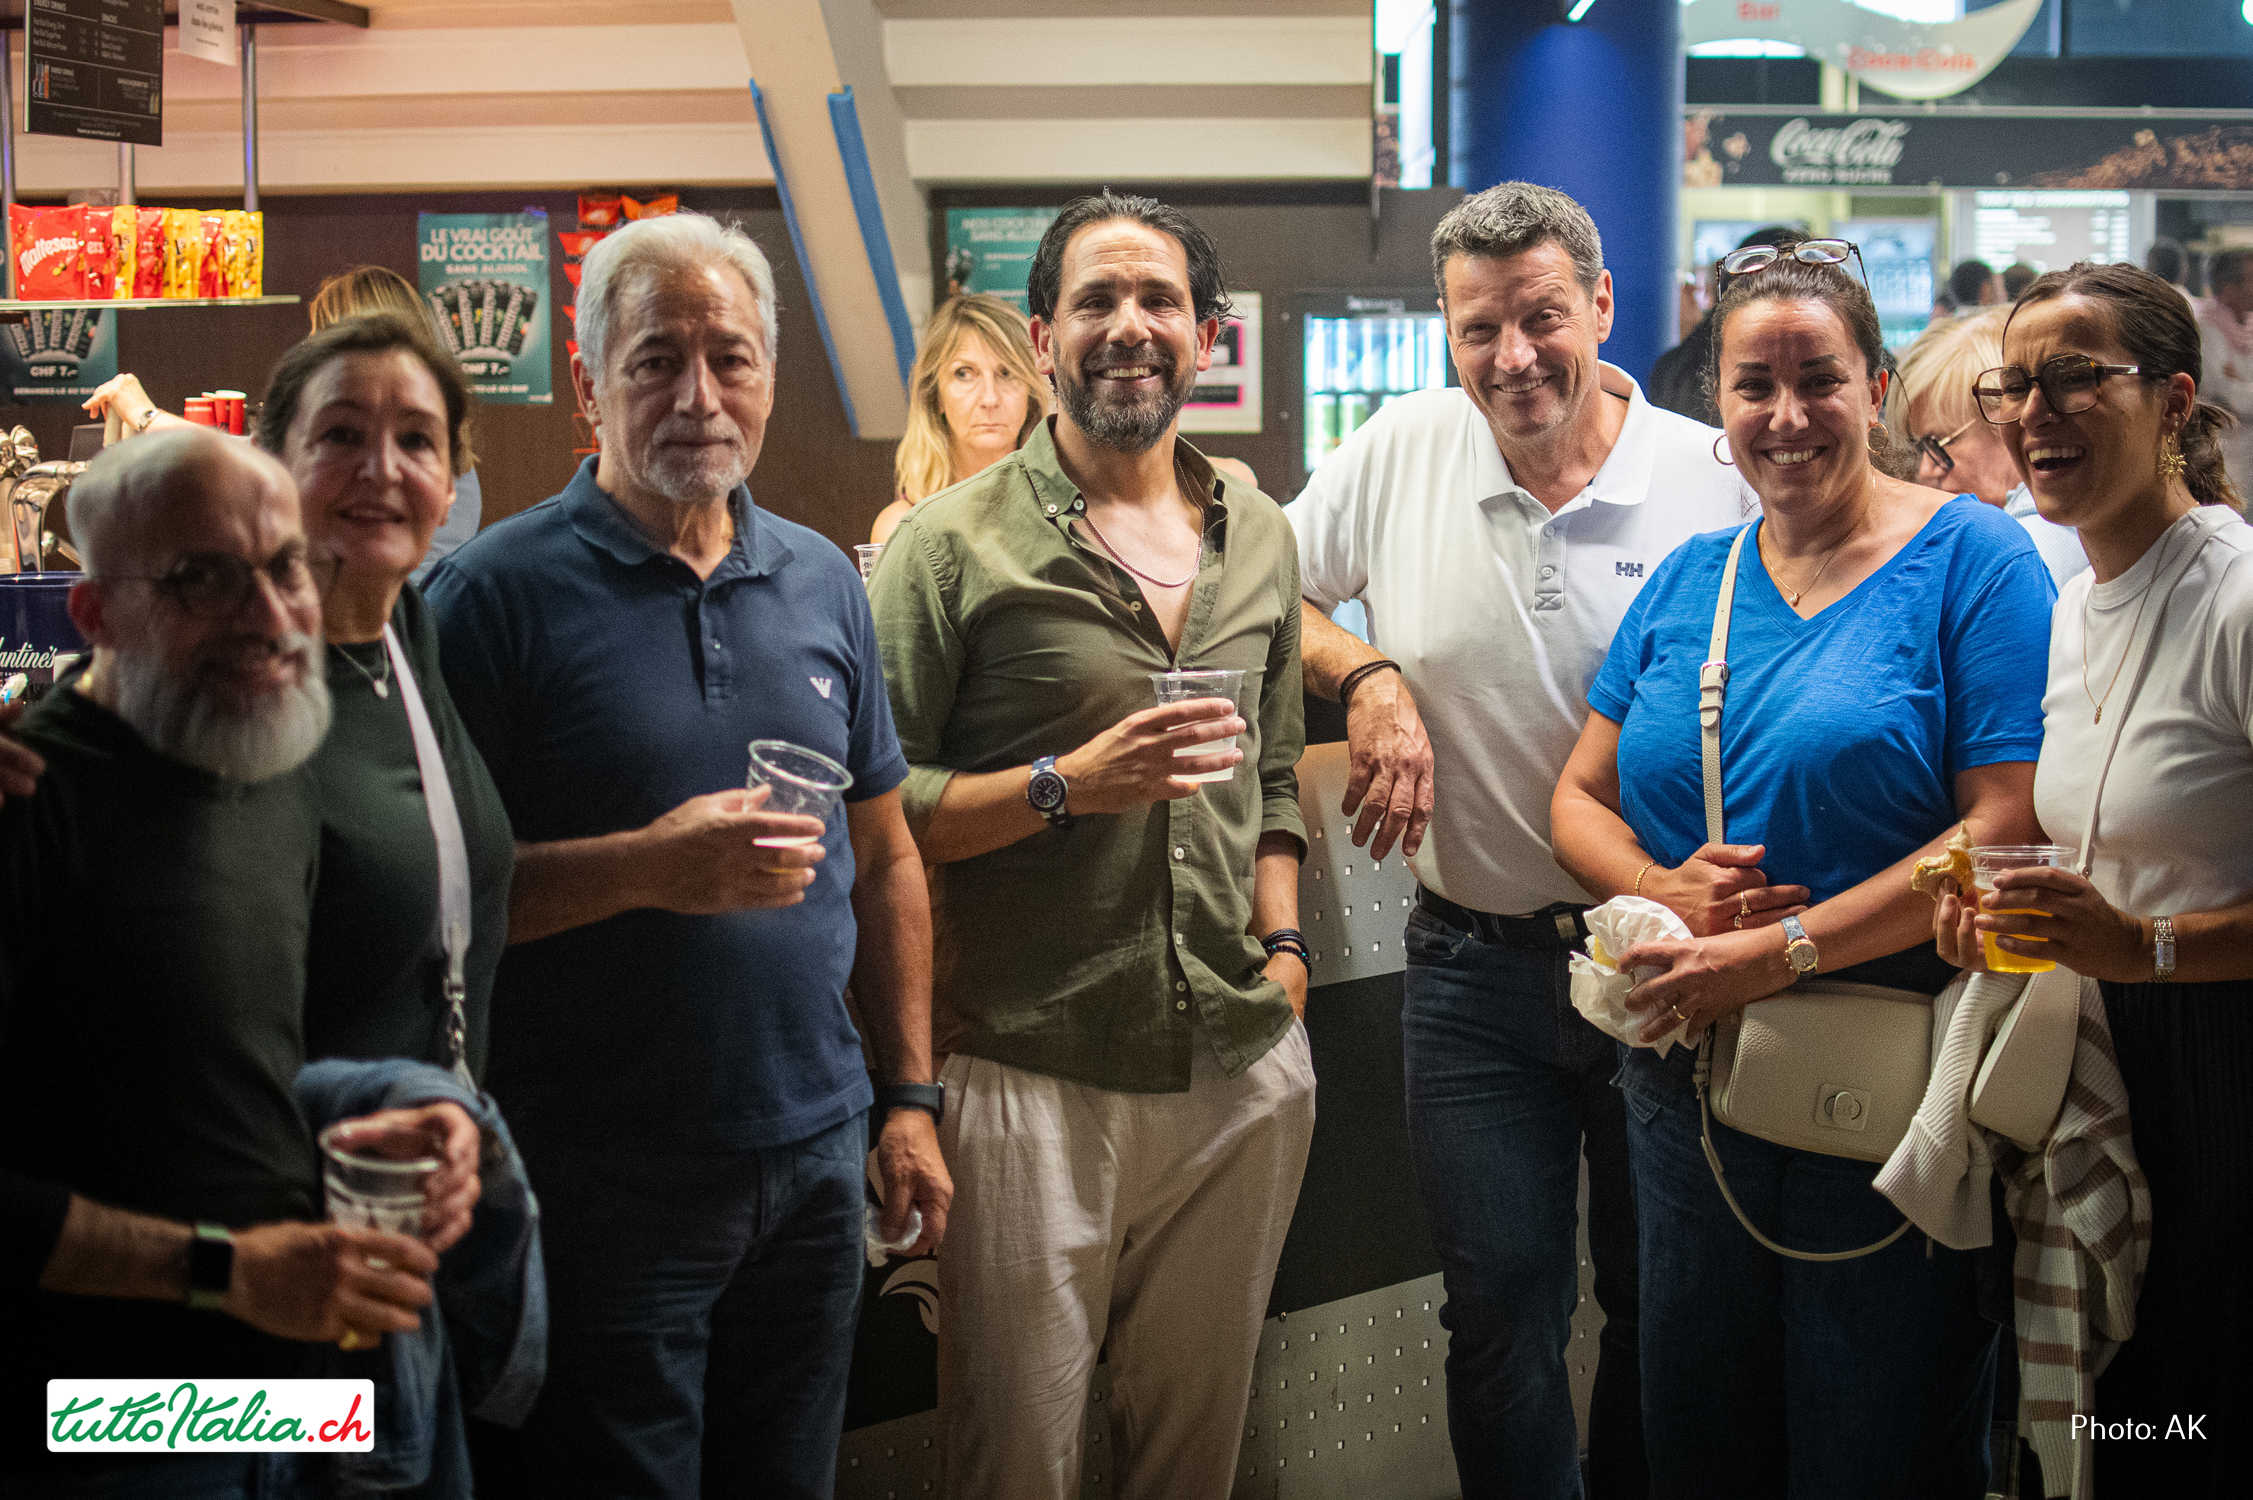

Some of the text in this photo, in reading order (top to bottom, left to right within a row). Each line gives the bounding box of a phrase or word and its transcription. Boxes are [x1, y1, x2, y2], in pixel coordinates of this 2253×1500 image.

[430, 228, 447, 243] LE
[449, 228, 487, 242] VRAI
[421, 243, 544, 262] DU COCKTAIL
